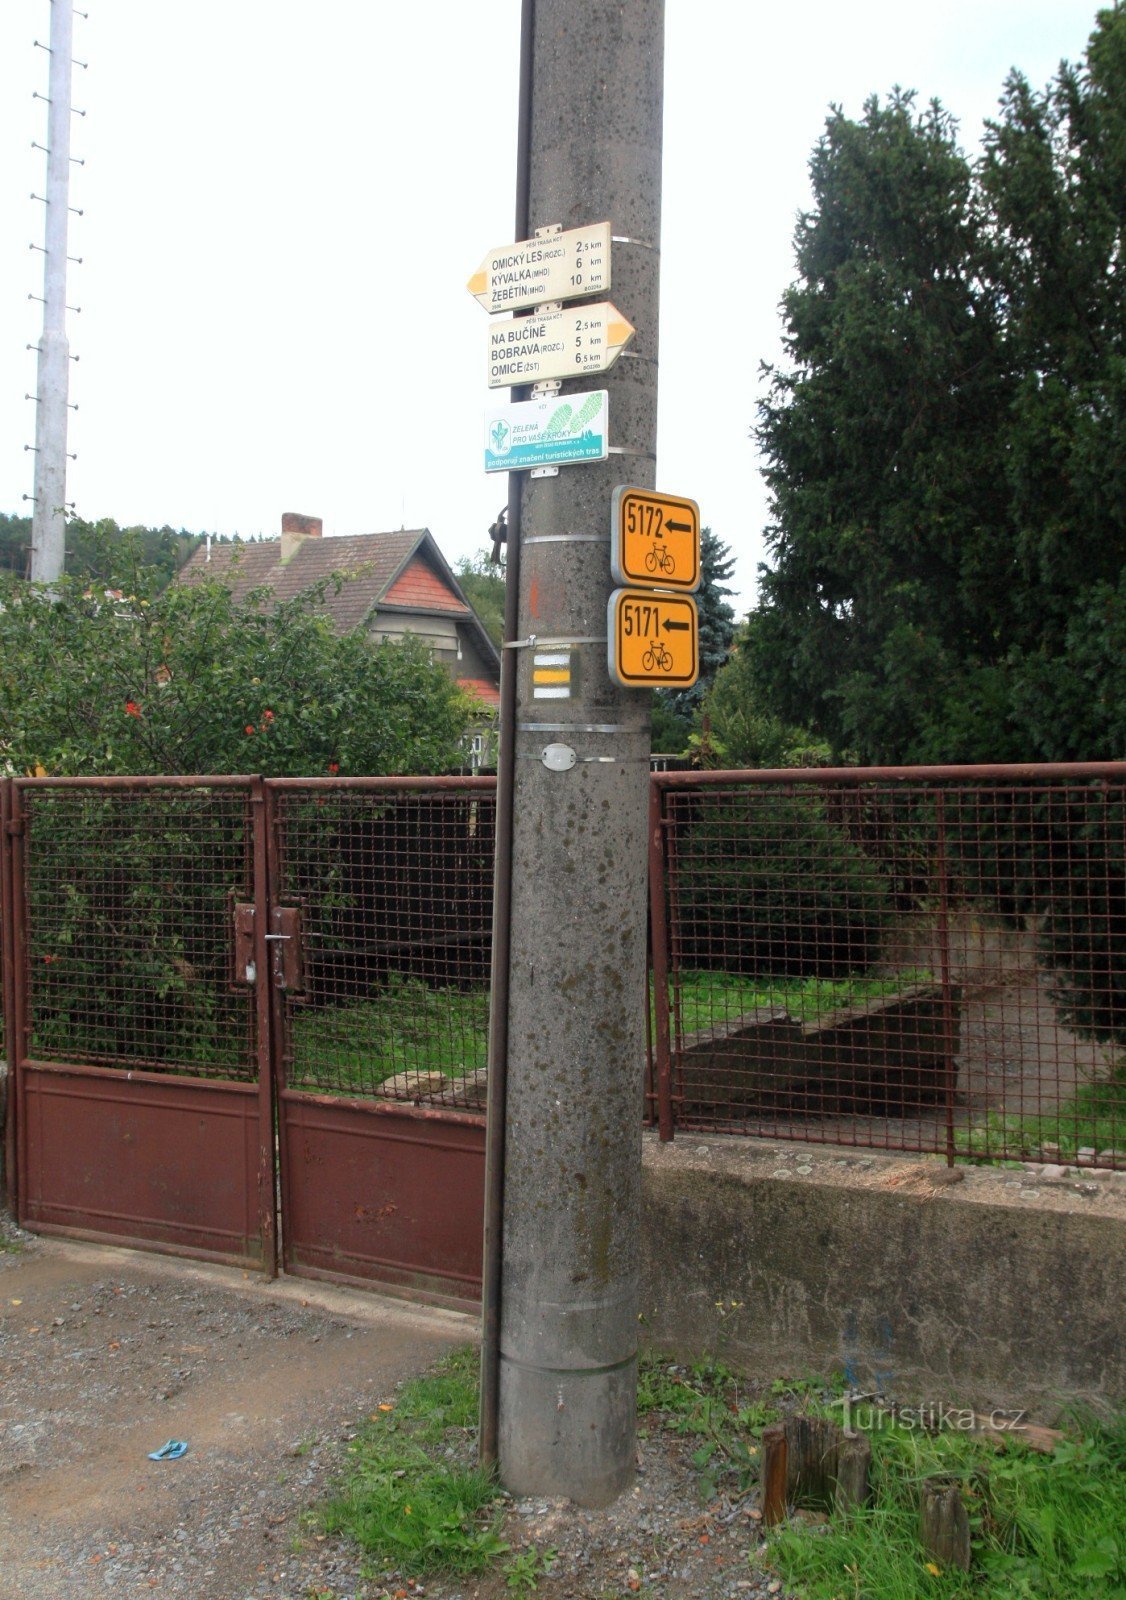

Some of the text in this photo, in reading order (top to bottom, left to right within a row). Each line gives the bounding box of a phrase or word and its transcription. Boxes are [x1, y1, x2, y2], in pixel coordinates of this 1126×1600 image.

[492, 252, 525, 271] OMICKÝ
[526, 250, 542, 264] LES
[590, 242, 602, 250] km
[576, 257, 582, 268] 6
[590, 258, 602, 266] km
[570, 274, 582, 286] 10
[492, 333, 506, 346] NA
[508, 324, 546, 342] BUČÍNĚ
[576, 336, 582, 348] 5
[512, 435, 526, 444] PRO
[519, 454, 544, 463] značení
[546, 448, 584, 460] turistických
[627, 502, 664, 538] 5172
[624, 605, 660, 638] 5171
